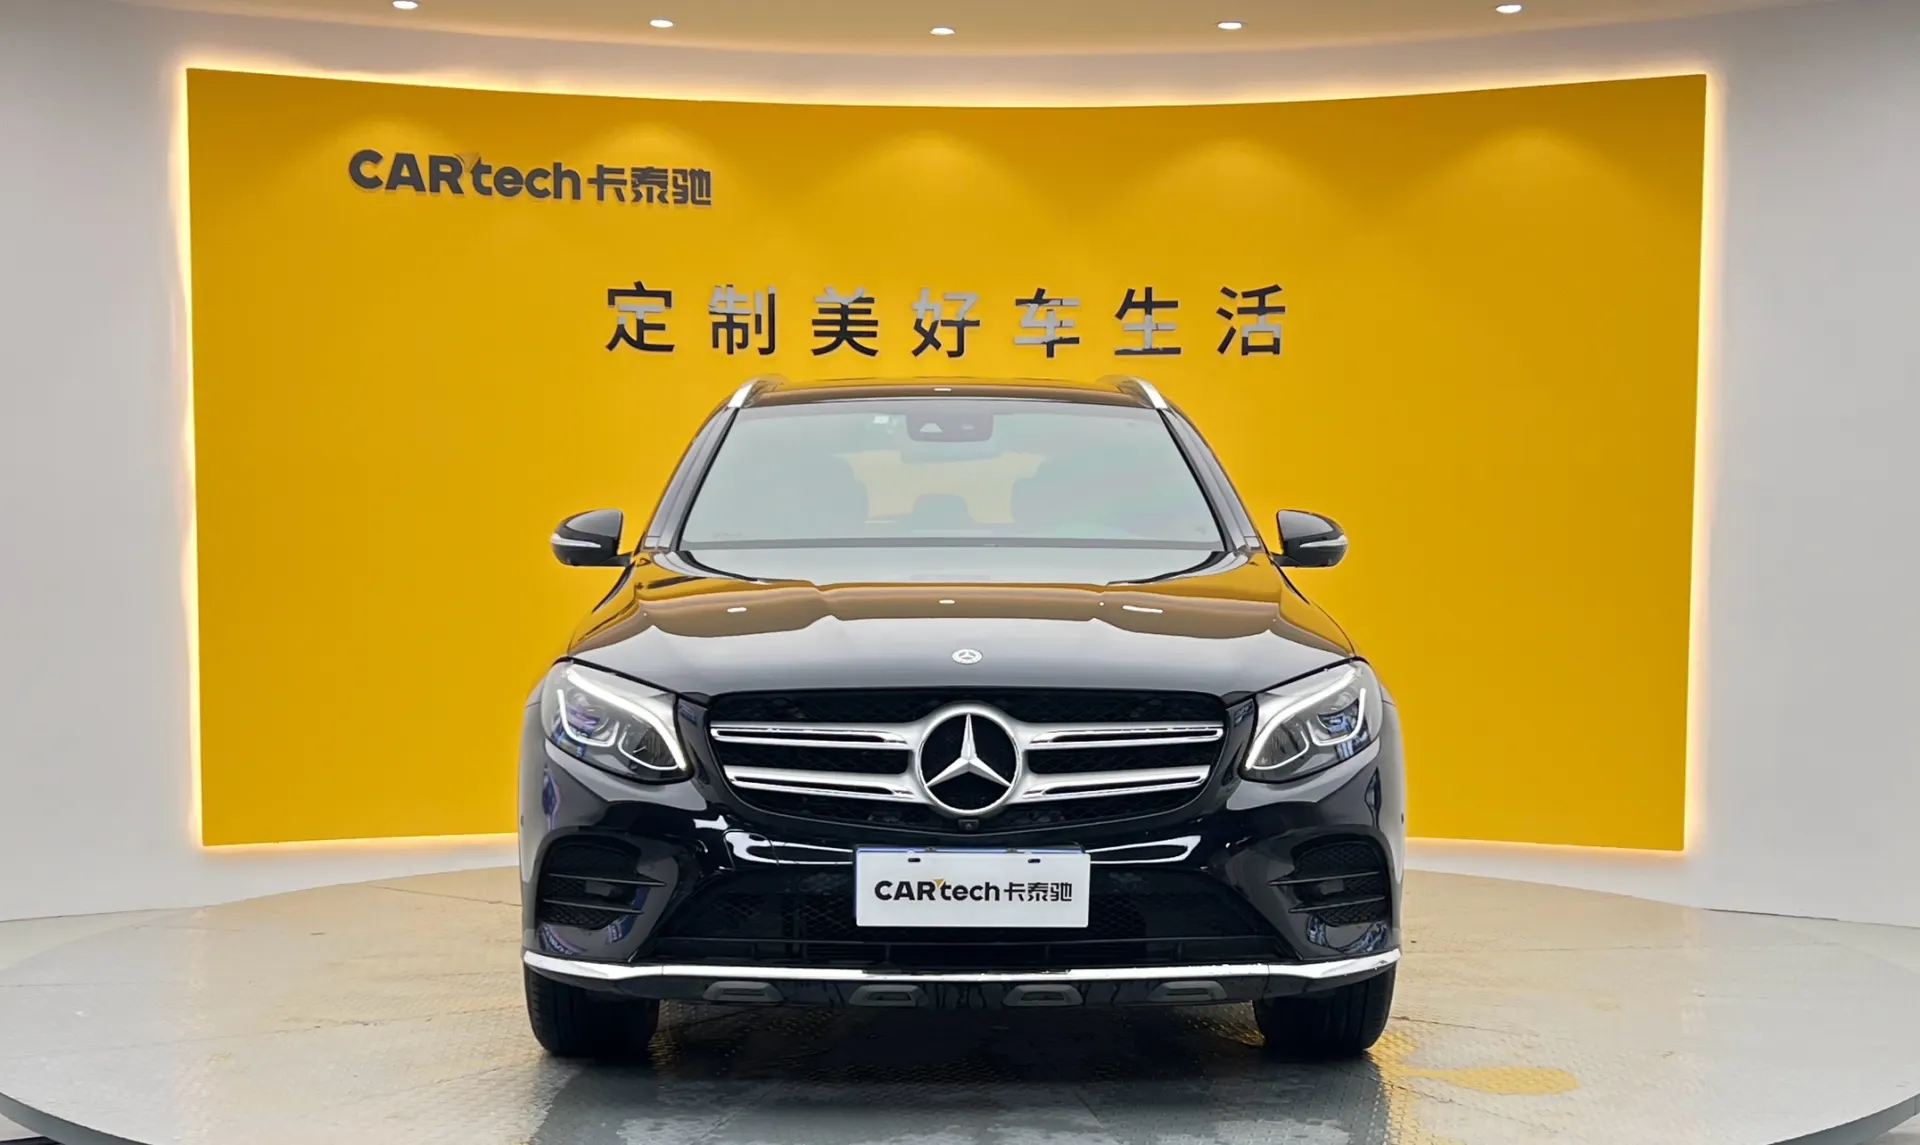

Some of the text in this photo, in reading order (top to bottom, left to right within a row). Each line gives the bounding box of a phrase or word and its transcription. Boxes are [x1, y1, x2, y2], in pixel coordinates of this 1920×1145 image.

[349, 149, 711, 205] CARtech 卡泰驰
[606, 281, 1286, 358] 定制美好车生活
[874, 880, 1072, 902] CARtech 卡泰驰
